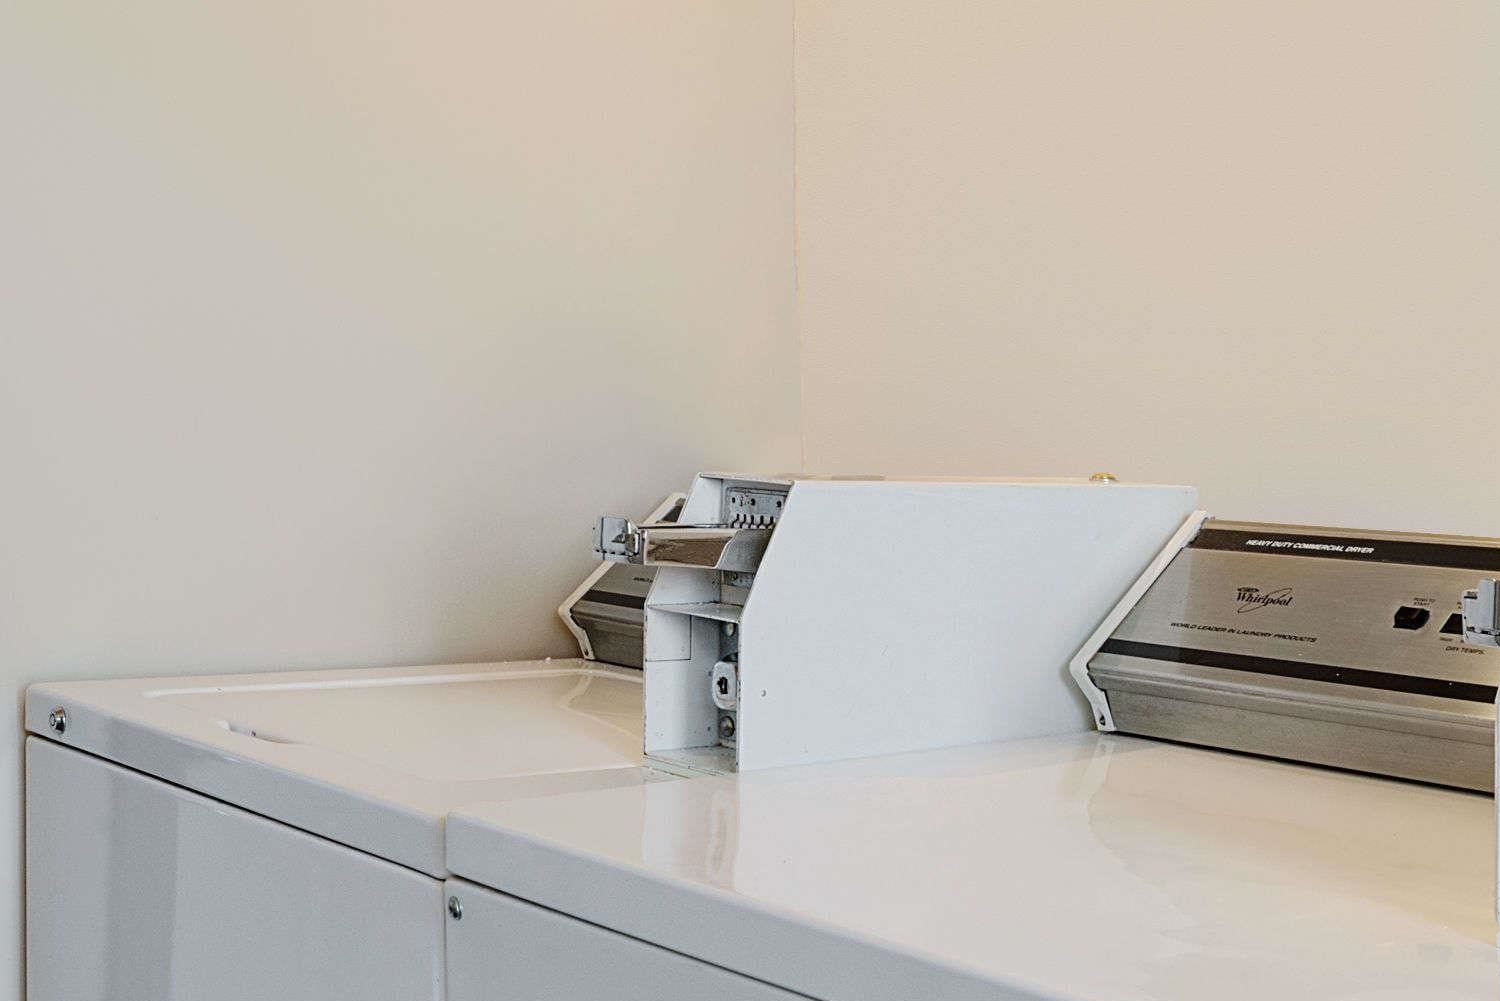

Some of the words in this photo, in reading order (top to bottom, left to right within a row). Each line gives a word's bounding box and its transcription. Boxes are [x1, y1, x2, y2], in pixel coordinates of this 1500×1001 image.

[1293, 543, 1345, 552] COMMERCIAL
[1345, 546, 1375, 554] DRYER
[1237, 591, 1293, 608] Whirlpool
[1171, 622, 1197, 630] WORLD
[1197, 624, 1227, 633] LEADER
[1273, 633, 1318, 643] PRODUCTS
